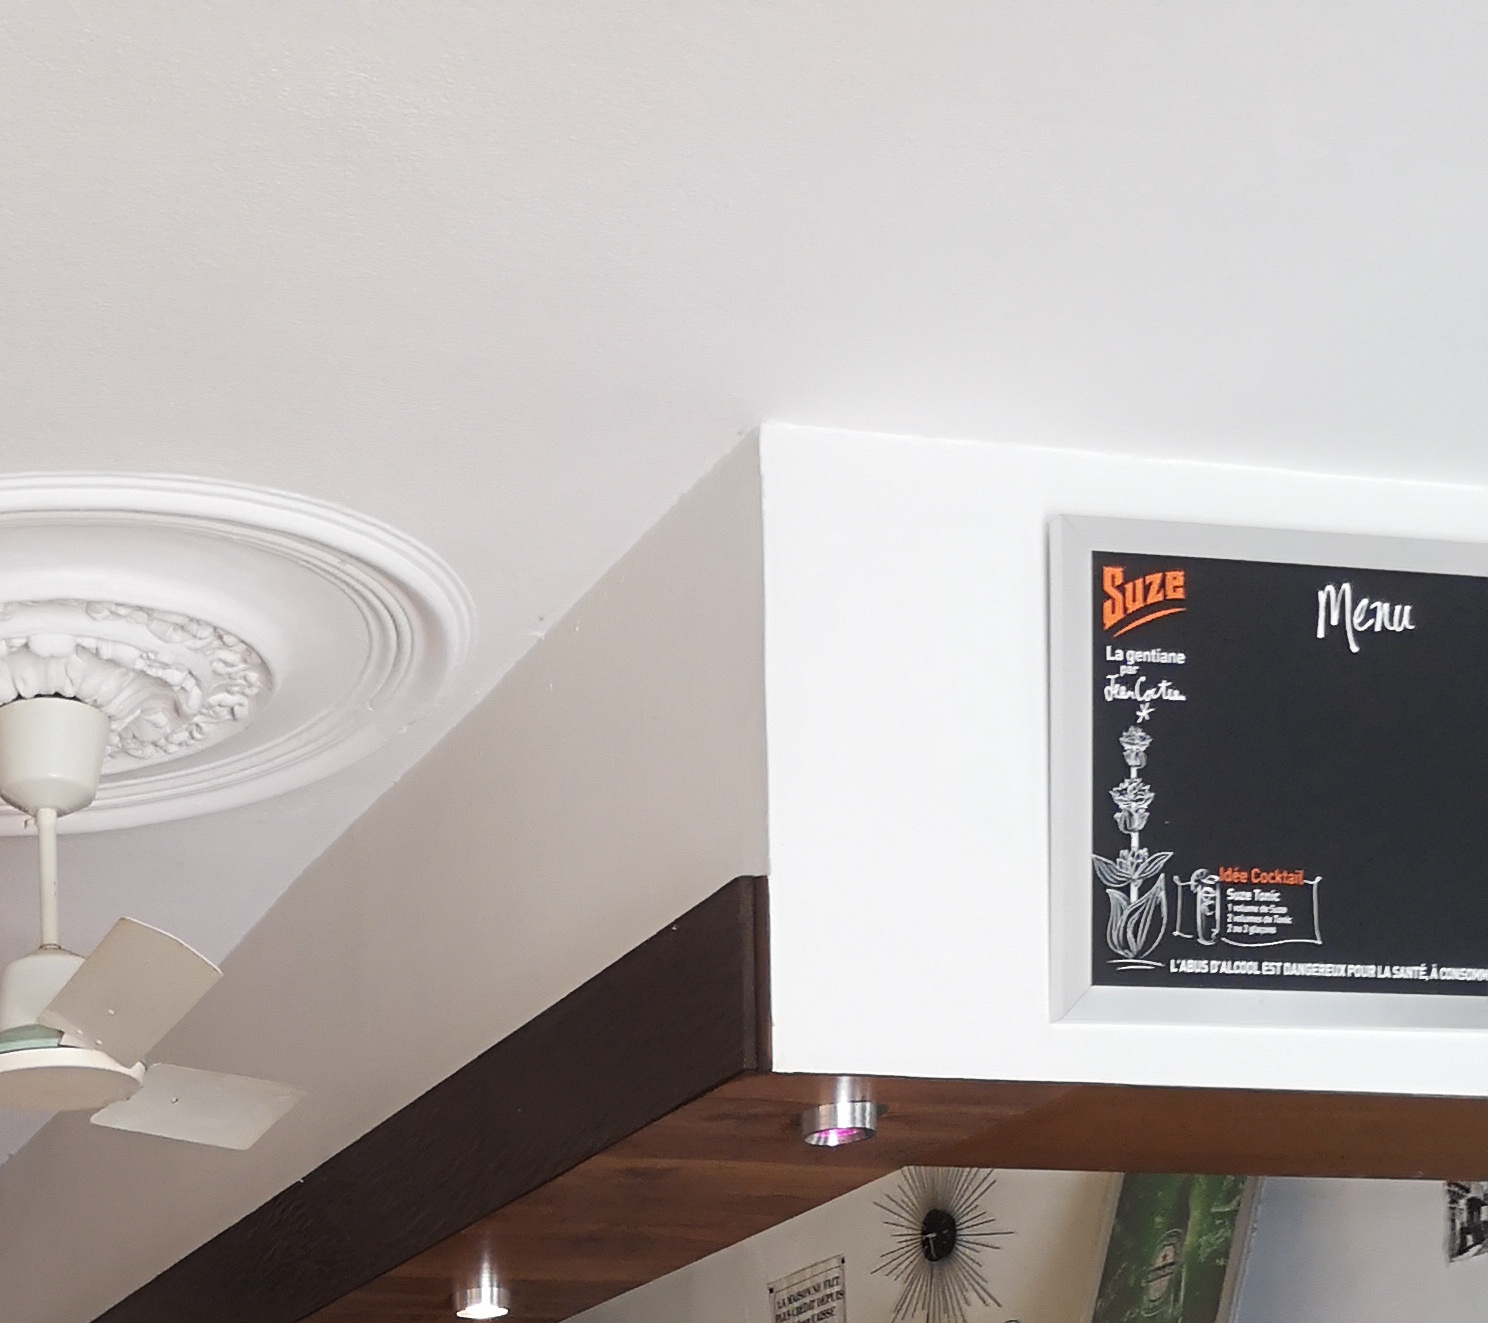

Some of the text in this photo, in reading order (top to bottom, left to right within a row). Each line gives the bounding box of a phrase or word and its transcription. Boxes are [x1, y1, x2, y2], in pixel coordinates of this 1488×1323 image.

[1102, 566, 1186, 631] Suze
[1316, 582, 1416, 653] Menu
[1105, 645, 1187, 665] La gentiane
[1120, 665, 1140, 677] par
[1218, 866, 1305, 886] Idée Cocktail
[1226, 887, 1282, 902] Suze Tonic
[1169, 959, 1209, 973] L'ABUS
[1210, 960, 1261, 975] D'ALCOOL
[1261, 961, 1283, 976] EST
[1283, 962, 1347, 978] DANGEREUX
[1347, 964, 1377, 978] POUR
[1377, 965, 1392, 979] LA
